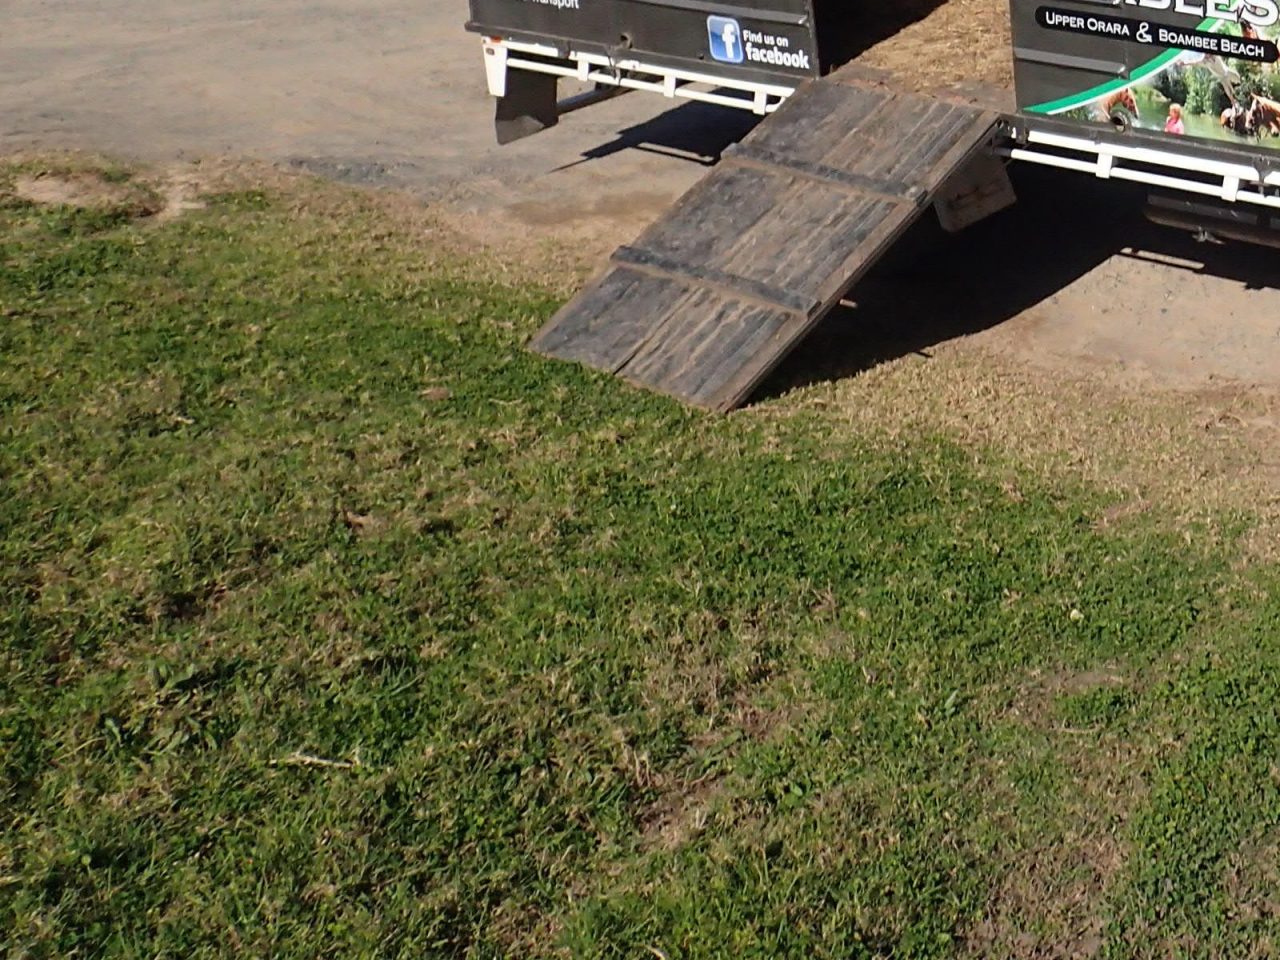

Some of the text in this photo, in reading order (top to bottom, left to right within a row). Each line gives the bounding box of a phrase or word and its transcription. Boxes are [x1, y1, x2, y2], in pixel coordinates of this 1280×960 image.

[742, 29, 789, 48] Find us on
[1045, 11, 1265, 58] UPPER ORARA & BOAMBEE BEACH
[745, 42, 810, 69] facebook
